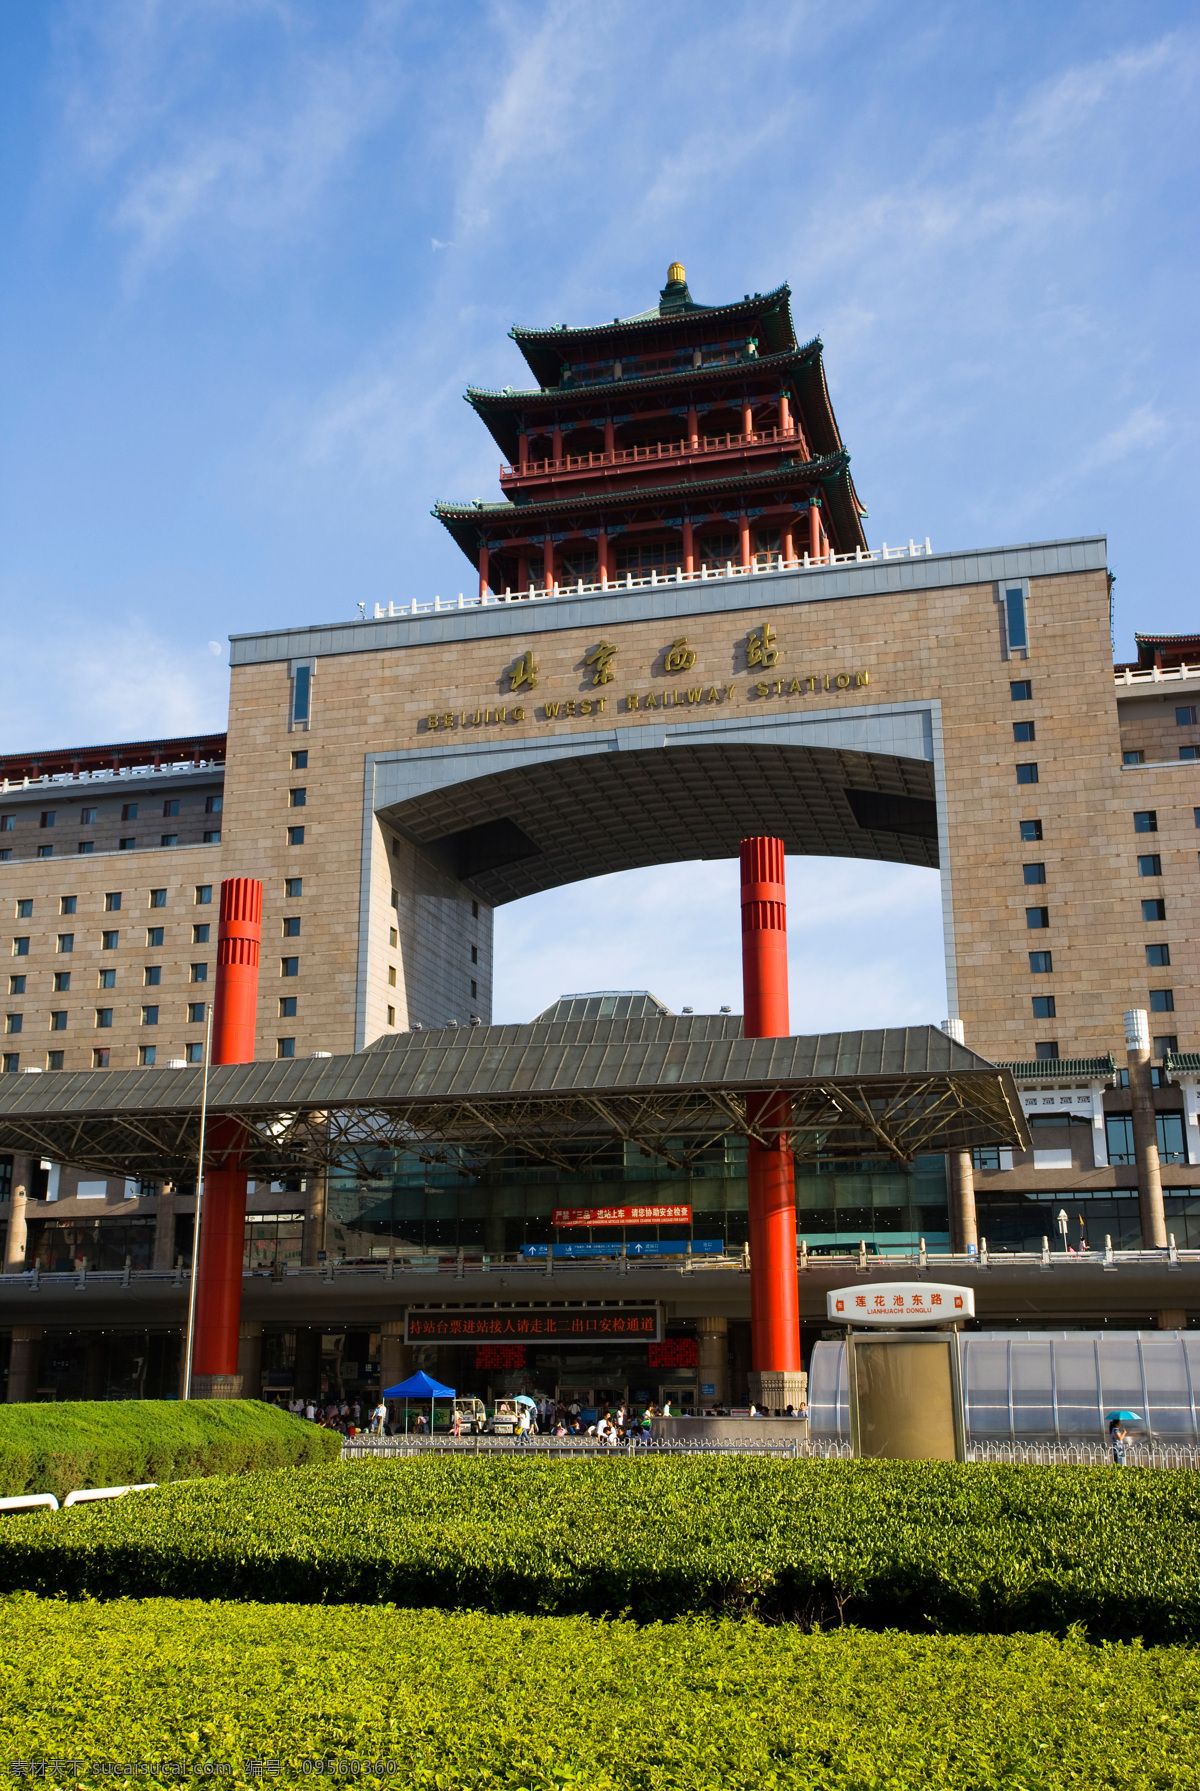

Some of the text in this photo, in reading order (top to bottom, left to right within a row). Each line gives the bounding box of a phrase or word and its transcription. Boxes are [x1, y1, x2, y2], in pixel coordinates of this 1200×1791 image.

[508, 622, 780, 693] 北京西站
[427, 669, 870, 729] BEIJING WEST RAILWAY STATION
[855, 1293, 943, 1308] 莲花池东路
[409, 1316, 654, 1334] 持站台票进站接人请走北二出口安检通道
